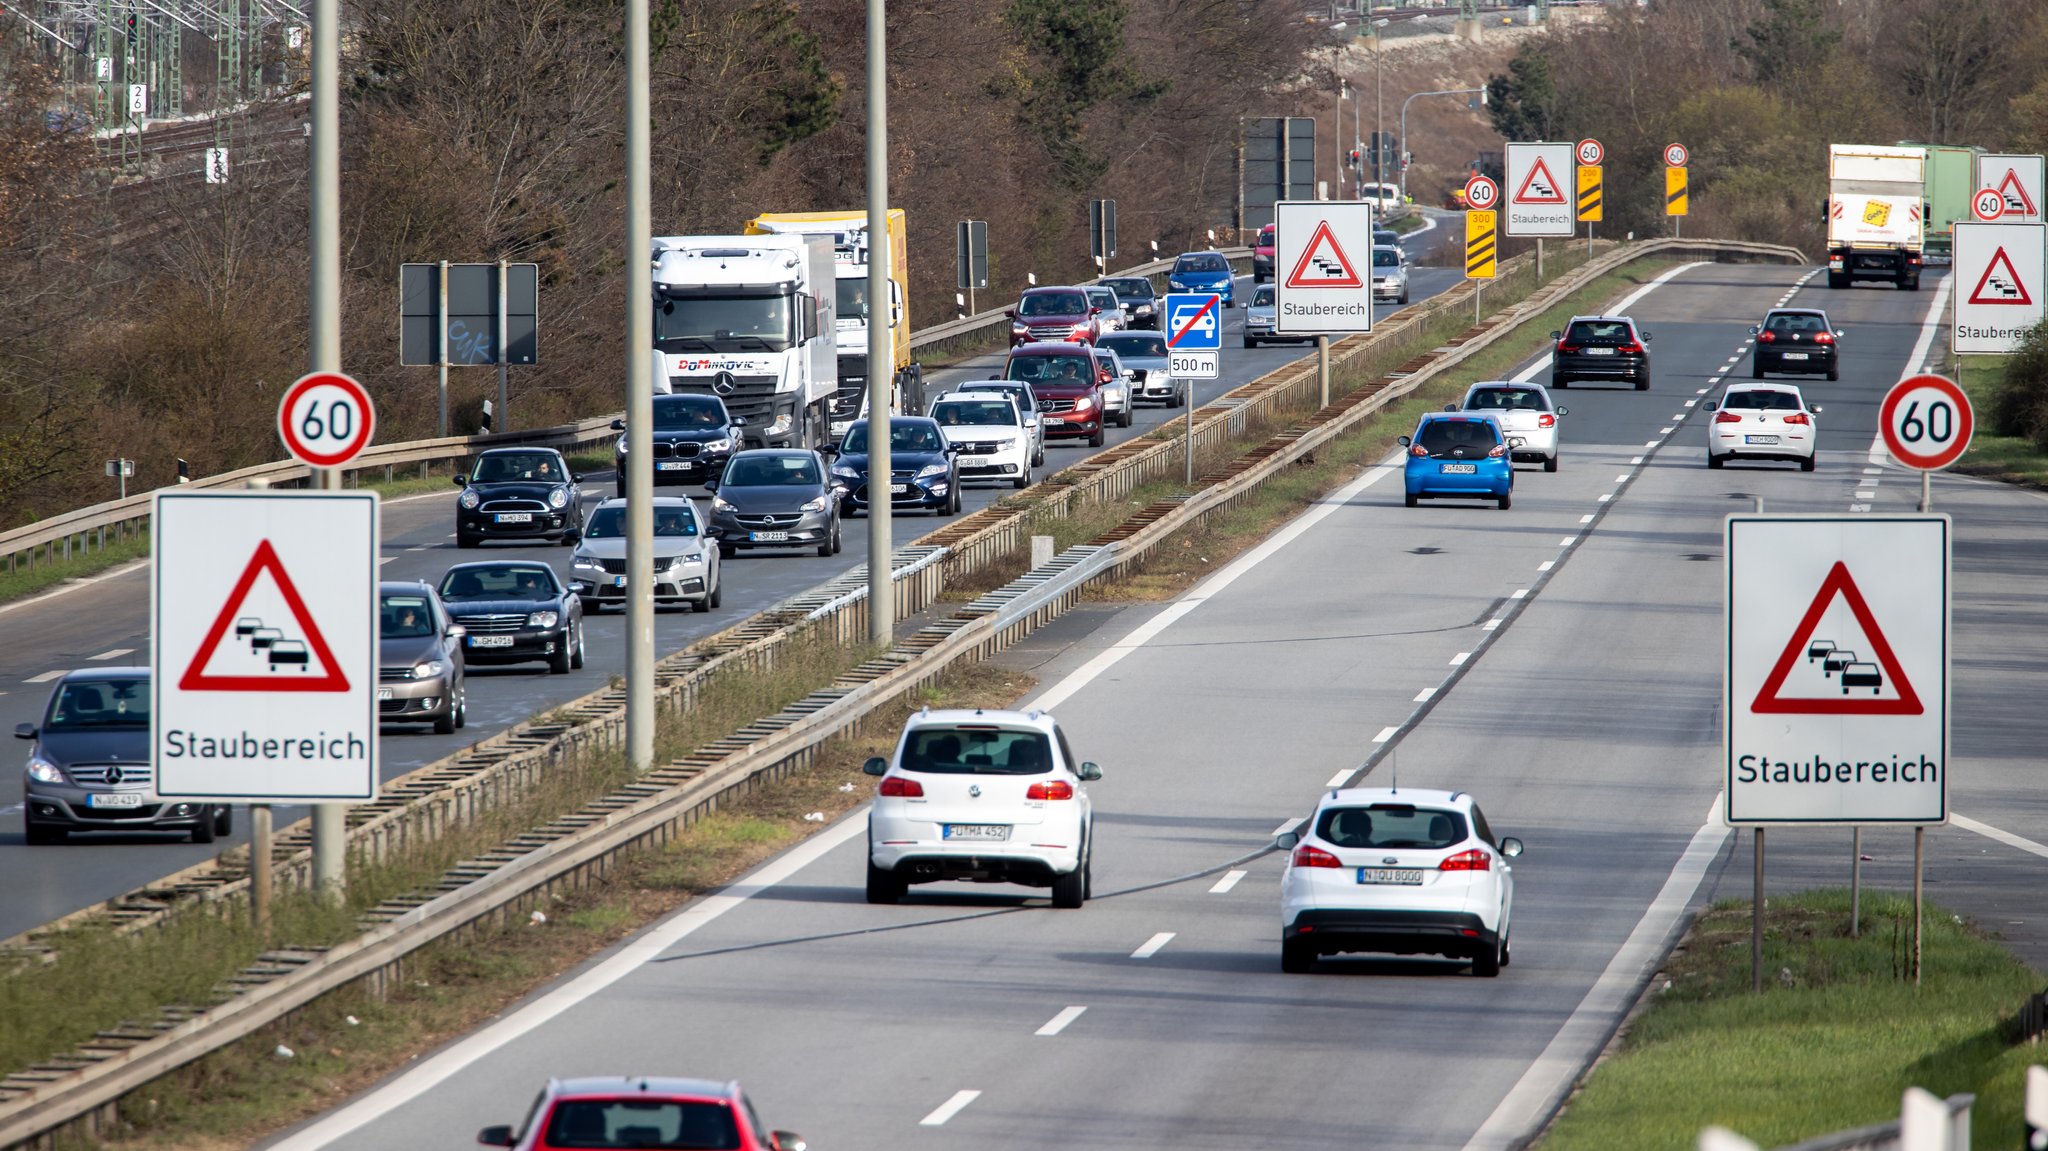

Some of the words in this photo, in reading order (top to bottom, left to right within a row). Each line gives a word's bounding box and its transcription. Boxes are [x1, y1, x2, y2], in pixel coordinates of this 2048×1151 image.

[1582, 146, 1598, 159] 60
[1669, 149, 1683, 161] 60
[1472, 185, 1491, 201] 60
[1980, 197, 1998, 212] 60
[1472, 214, 1490, 223] 300
[1511, 213, 1569, 224] Staubereich
[1283, 302, 1365, 317] Staubereich
[1172, 358, 1198, 371] 500
[1201, 361, 1214, 371] m
[302, 399, 352, 441] 60
[1900, 400, 1953, 443] 60
[165, 730, 365, 760] Staubereich
[1737, 754, 1937, 784] Staubereich
[985, 826, 1004, 837] 452
[1364, 870, 1371, 880] N
[1395, 871, 1421, 881] 8000
